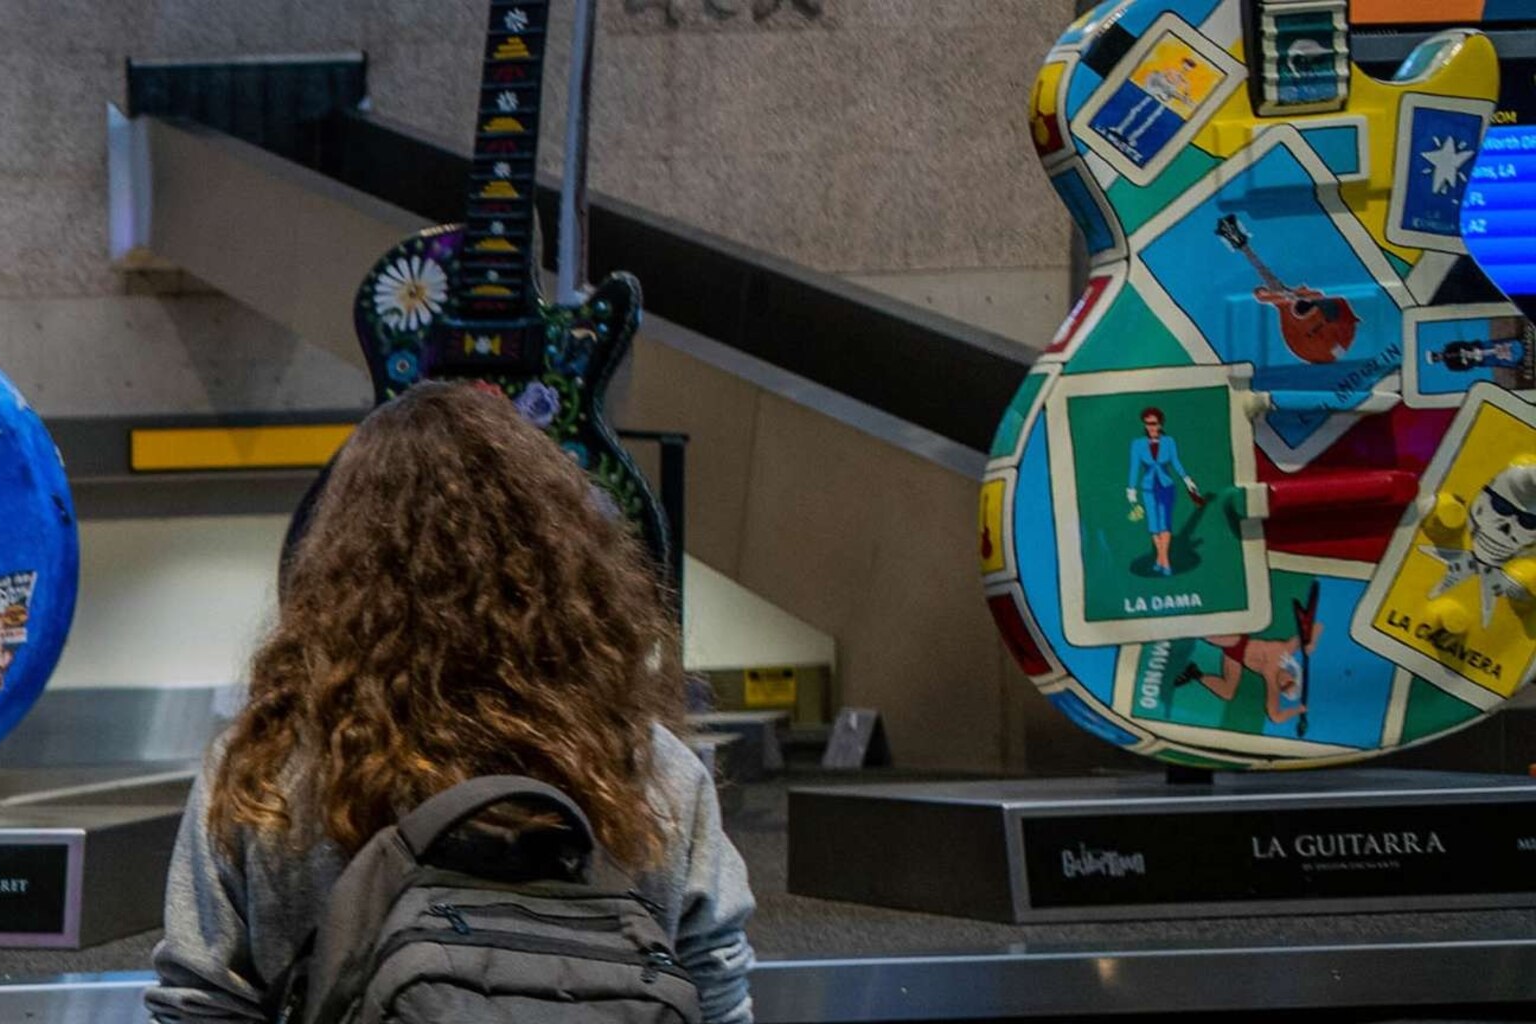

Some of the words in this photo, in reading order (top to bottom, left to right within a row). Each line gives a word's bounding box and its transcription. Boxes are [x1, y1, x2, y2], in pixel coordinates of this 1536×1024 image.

[1124, 597, 1147, 613] LA
[1150, 593, 1202, 610] DAMA
[1385, 609, 1411, 633] LA
[1139, 640, 1171, 709] MUNDO
[1251, 836, 1287, 858] LA
[1294, 831, 1447, 857] GUITARRA
